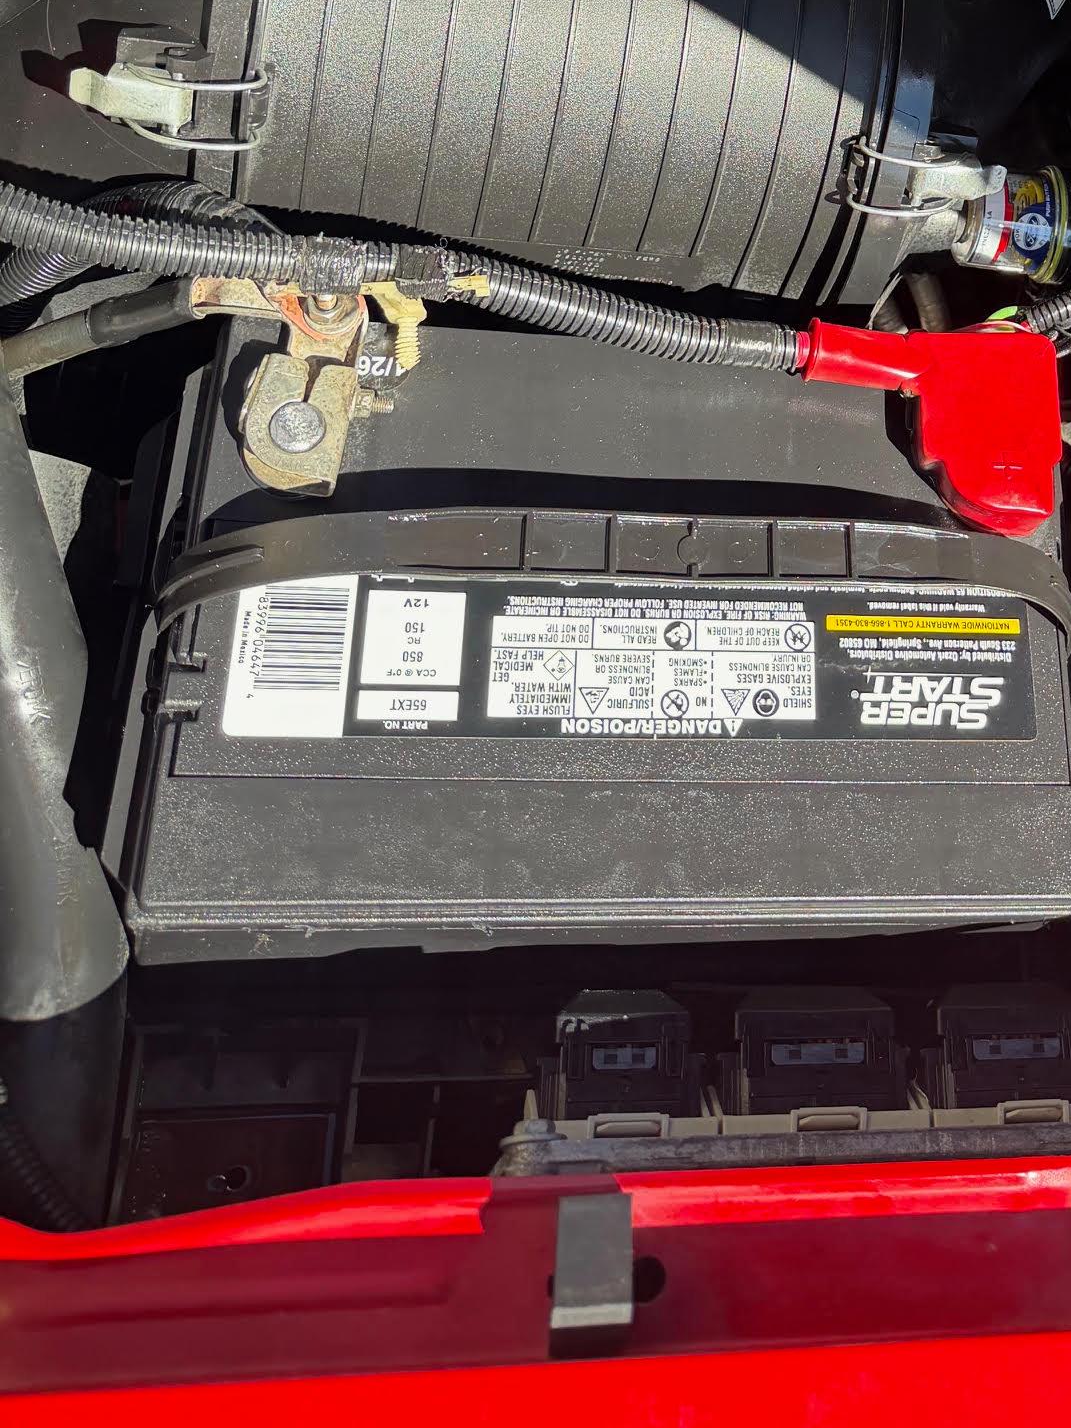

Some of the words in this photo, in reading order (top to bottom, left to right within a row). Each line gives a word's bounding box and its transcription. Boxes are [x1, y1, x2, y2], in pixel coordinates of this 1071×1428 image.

[404, 598, 429, 607] 12V
[566, 598, 603, 607] CHARGING
[604, 598, 634, 608] PROPER
[635, 599, 664, 609] FOLLOW
[684, 600, 717, 610] INVERTED
[720, 601, 733, 610] FOR
[735, 601, 788, 611] RECOMMENDED
[790, 602, 803, 611] NOT
[901, 602, 918, 611] label
[955, 602, 985, 612] Warranty
[550, 607, 560, 616] OR
[562, 607, 612, 617] DISASSEMBLE
[614, 608, 628, 617] NOT
[630, 608, 641, 617] DO
[672, 610, 681, 618] OR
[684, 610, 722, 619] EXPLOSION
[743, 611, 752, 619] OF
[754, 611, 770, 620] RISK
[405, 622, 425, 633] 150
[561, 624, 576, 632] NOT
[579, 624, 589, 632] DO
[894, 620, 913, 628] CALL
[916, 621, 959, 629] WARRANTY
[962, 622, 1009, 630] NATIONWIDE
[600, 624, 657, 634] INSTRUCTIONS.
[745, 627, 754, 635] OF
[756, 628, 779, 636] REACH
[407, 636, 421, 644] RC
[501, 632, 536, 642] BATTERY.
[539, 634, 558, 643] OPEN
[561, 634, 576, 643] NOT
[579, 634, 588, 643] DO
[622, 635, 634, 644] ALL
[638, 636, 657, 644] READ
[719, 637, 732, 645] THE
[735, 637, 743, 645] OF
[746, 637, 760, 645] OUT
[762, 637, 779, 645] KEEP
[840, 638, 863, 647] 65802
[864, 638, 877, 647] MO
[944, 639, 978, 649] Patterson
[980, 640, 1000, 649] South
[1002, 640, 1016, 649] 233
[238, 640, 246, 664] Mexico
[403, 651, 423, 662] 850
[494, 650, 518, 660] FAST.
[522, 650, 544, 660] HELP
[895, 650, 936, 660] Automotive
[938, 651, 958, 660] Ozark
[973, 651, 1012, 662] Distributed
[248, 639, 263, 677] 04647
[592, 654, 620, 662] BURNS.
[622, 654, 650, 662] SEVERE
[493, 661, 533, 671] MEDICAL
[596, 665, 606, 673] OR
[608, 665, 650, 673] BLINDNESS
[729, 663, 769, 671] BLINDNESS
[772, 663, 794, 671] CAUSE
[797, 663, 811, 671] CAN
[416, 669, 436, 677] CCA
[492, 672, 509, 682] GET
[608, 676, 632, 684] CAUSE
[635, 676, 650, 684] CAN
[737, 674, 763, 683] GASES
[766, 674, 811, 683] EXPLOSIVE
[511, 682, 546, 692] WATER.
[548, 682, 571, 692] WITH
[630, 687, 649, 696] ACID
[788, 686, 811, 695] EYES.
[860, 676, 1004, 706] START
[509, 693, 571, 704] IMMEDIATELY
[696, 697, 707, 706] NO
[783, 698, 811, 708] SHIELD
[390, 699, 427, 711] 65EXT
[607, 699, 649, 709] SULFURIC
[516, 705, 539, 715] EYES
[543, 705, 570, 715] FLUSH
[860, 702, 989, 729] SUPER
[382, 720, 399, 729] NO.
[402, 720, 428, 729] PART
[561, 719, 721, 734] DANGER/POISON
